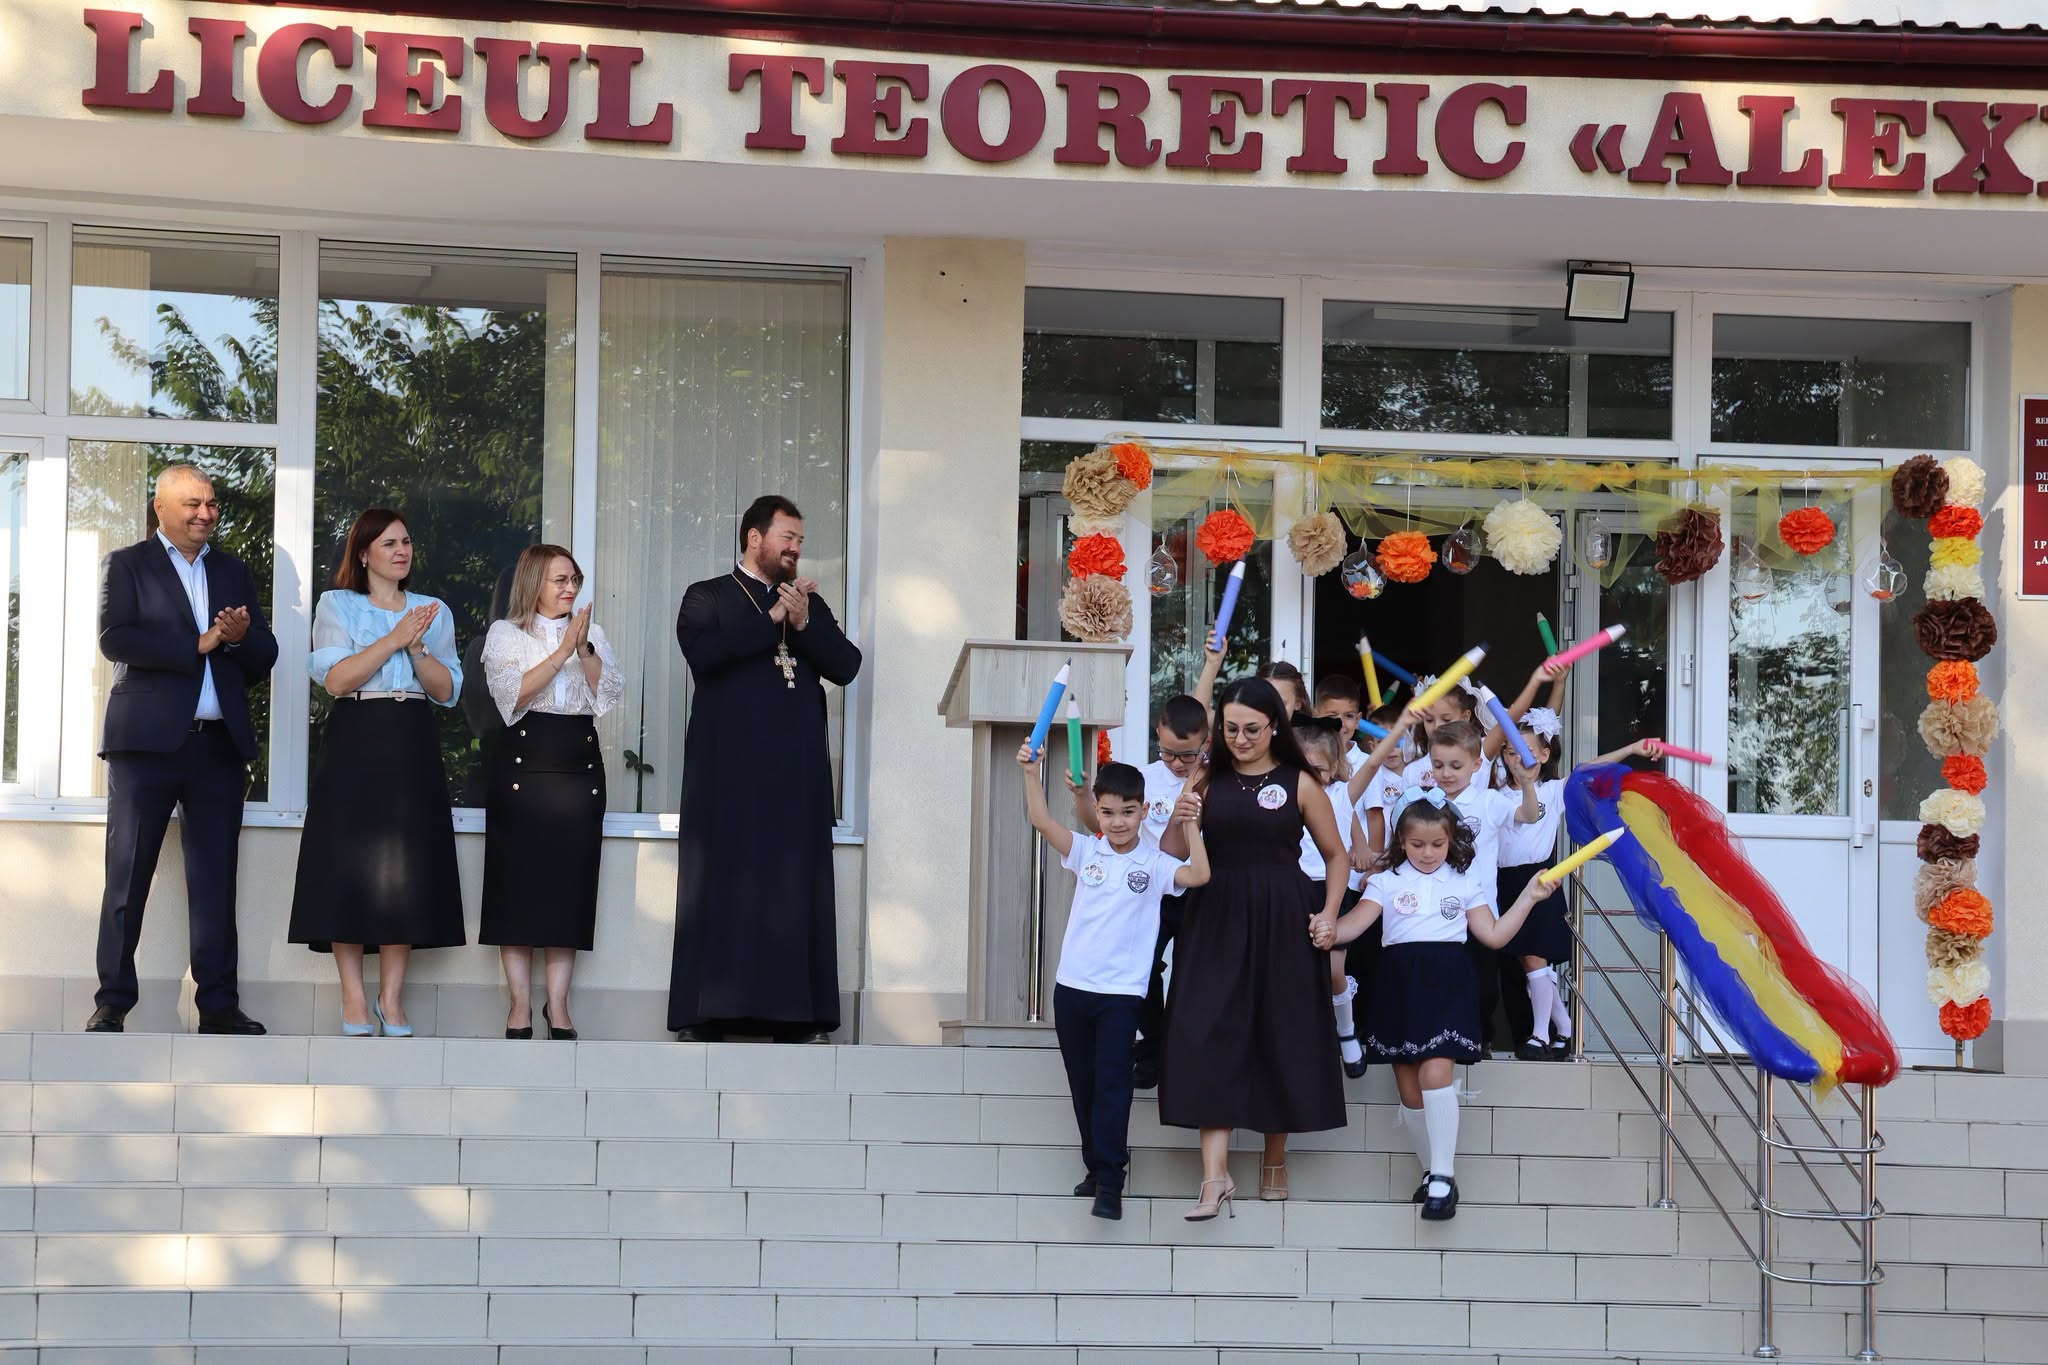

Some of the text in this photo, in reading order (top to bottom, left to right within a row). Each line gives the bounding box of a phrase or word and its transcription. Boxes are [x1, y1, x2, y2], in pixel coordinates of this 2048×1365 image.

[83, 9, 2048, 196] LICEUL TEORETIC «ALEX
[2035, 471, 2048, 481] DI
